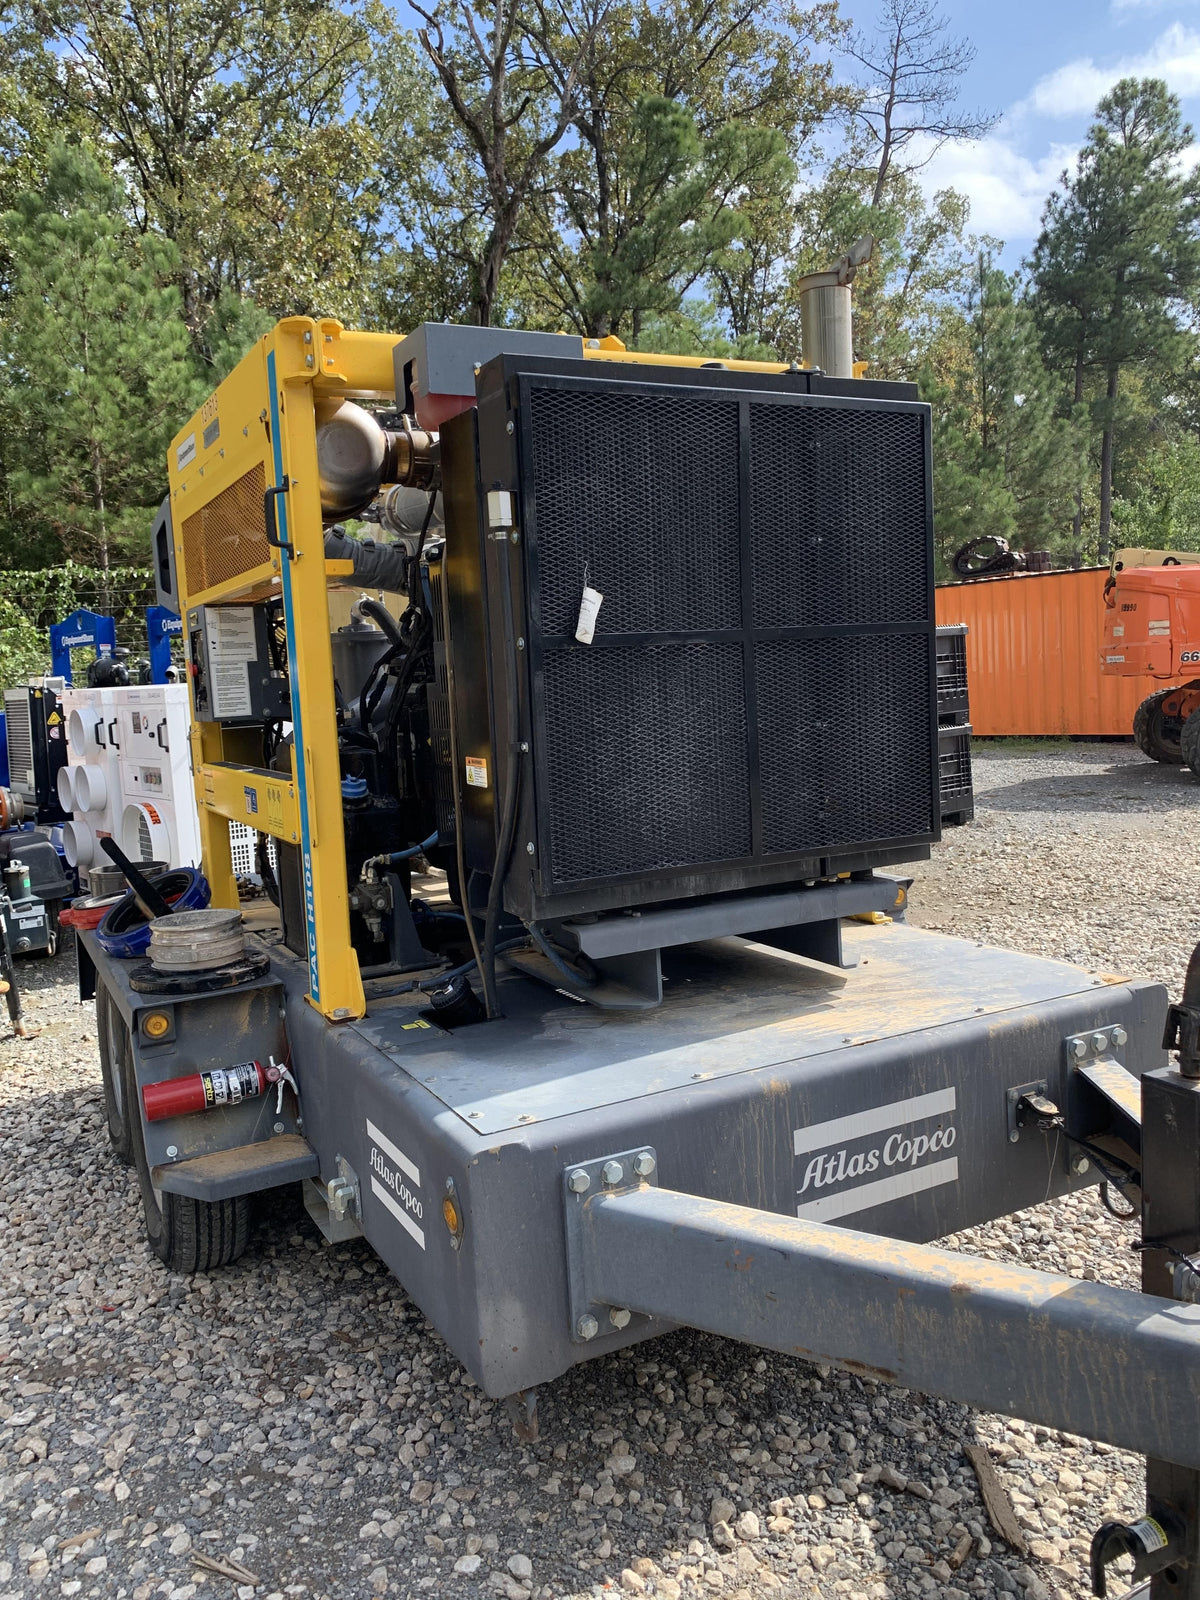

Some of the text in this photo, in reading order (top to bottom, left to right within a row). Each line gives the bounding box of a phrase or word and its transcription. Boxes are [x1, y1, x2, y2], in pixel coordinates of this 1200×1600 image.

[304, 852, 319, 993] PAC H108
[203, 1076, 214, 1101] sentry
[370, 1147, 423, 1219] Atlas Copco
[796, 1126, 957, 1194] Atlas Copco
